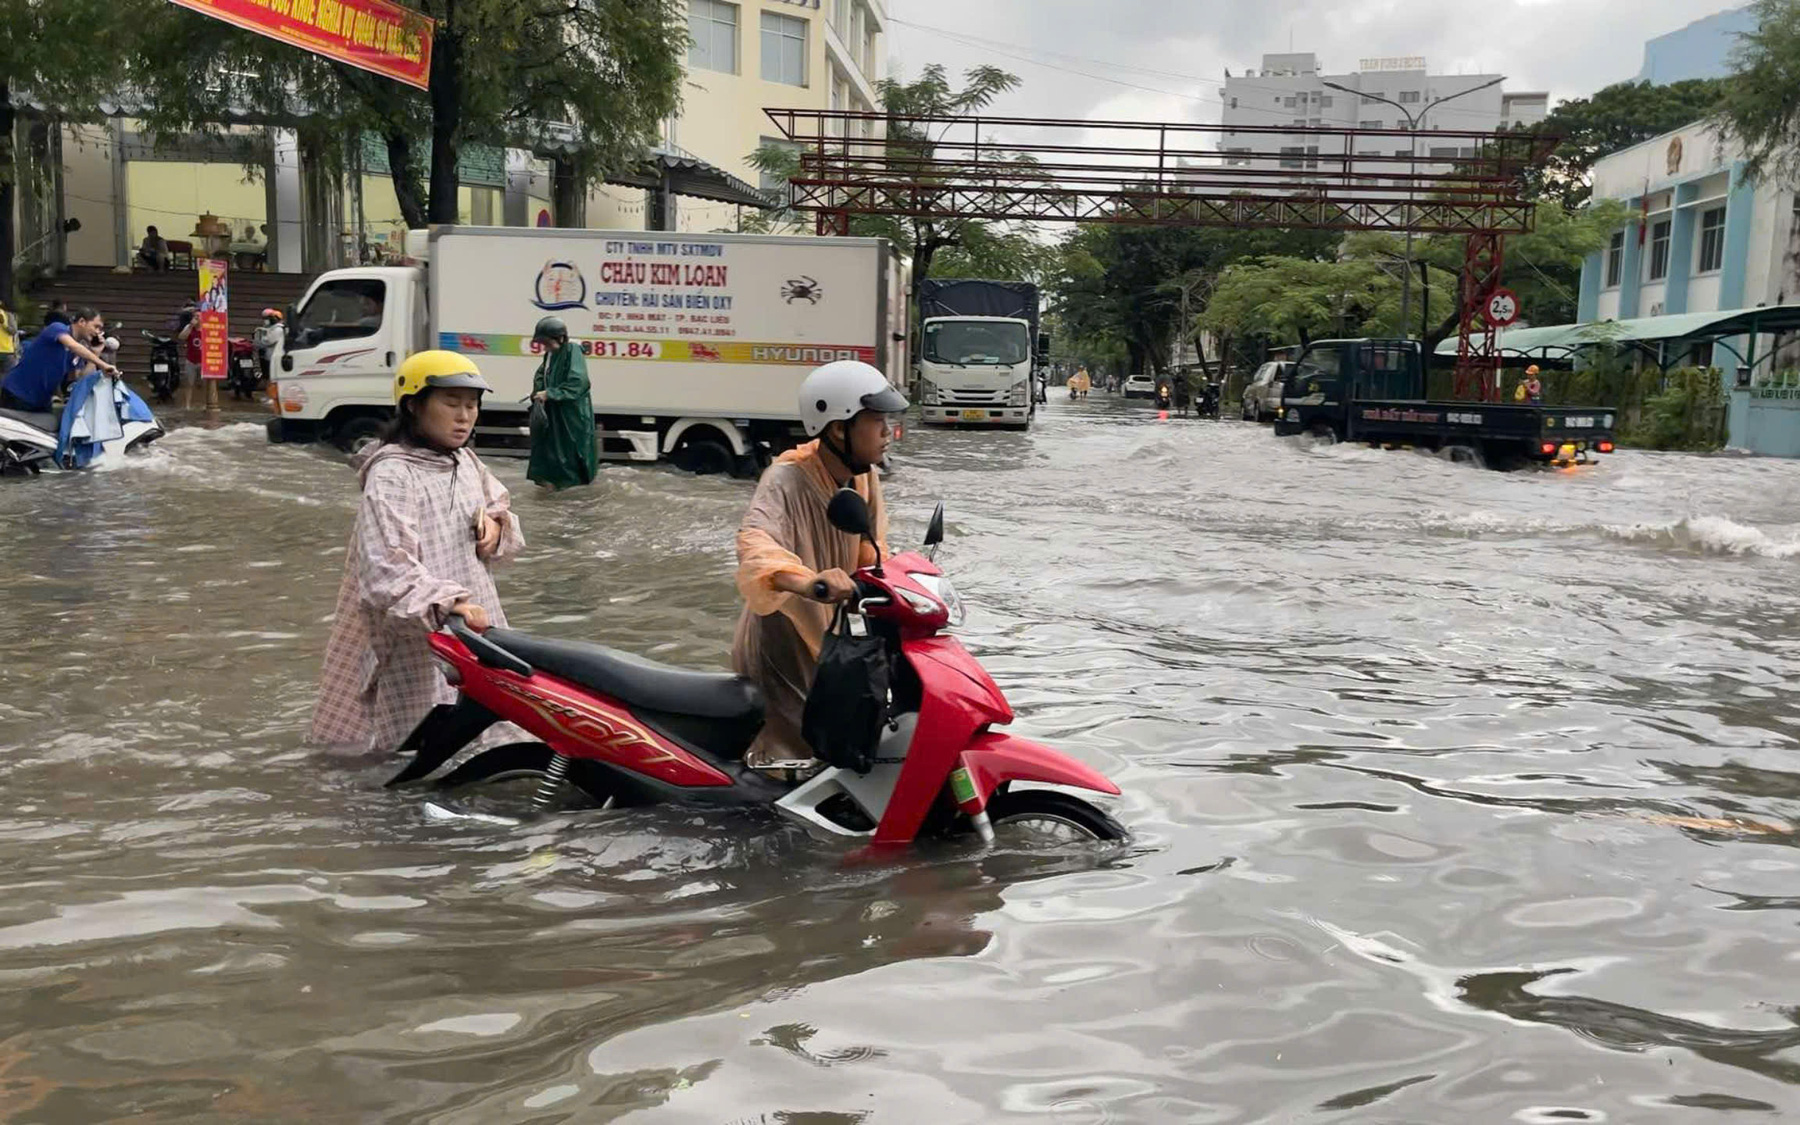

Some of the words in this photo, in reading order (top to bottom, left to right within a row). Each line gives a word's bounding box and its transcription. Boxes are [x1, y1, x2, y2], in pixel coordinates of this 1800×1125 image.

[606, 242, 624, 254] CTY
[627, 242, 654, 254] TNHH
[657, 243, 679, 255] MTV
[650, 263, 681, 285] KIM
[684, 264, 727, 287] LOAN
[641, 288, 659, 307] HẢI
[751, 347, 861, 362] HYUNDAI
